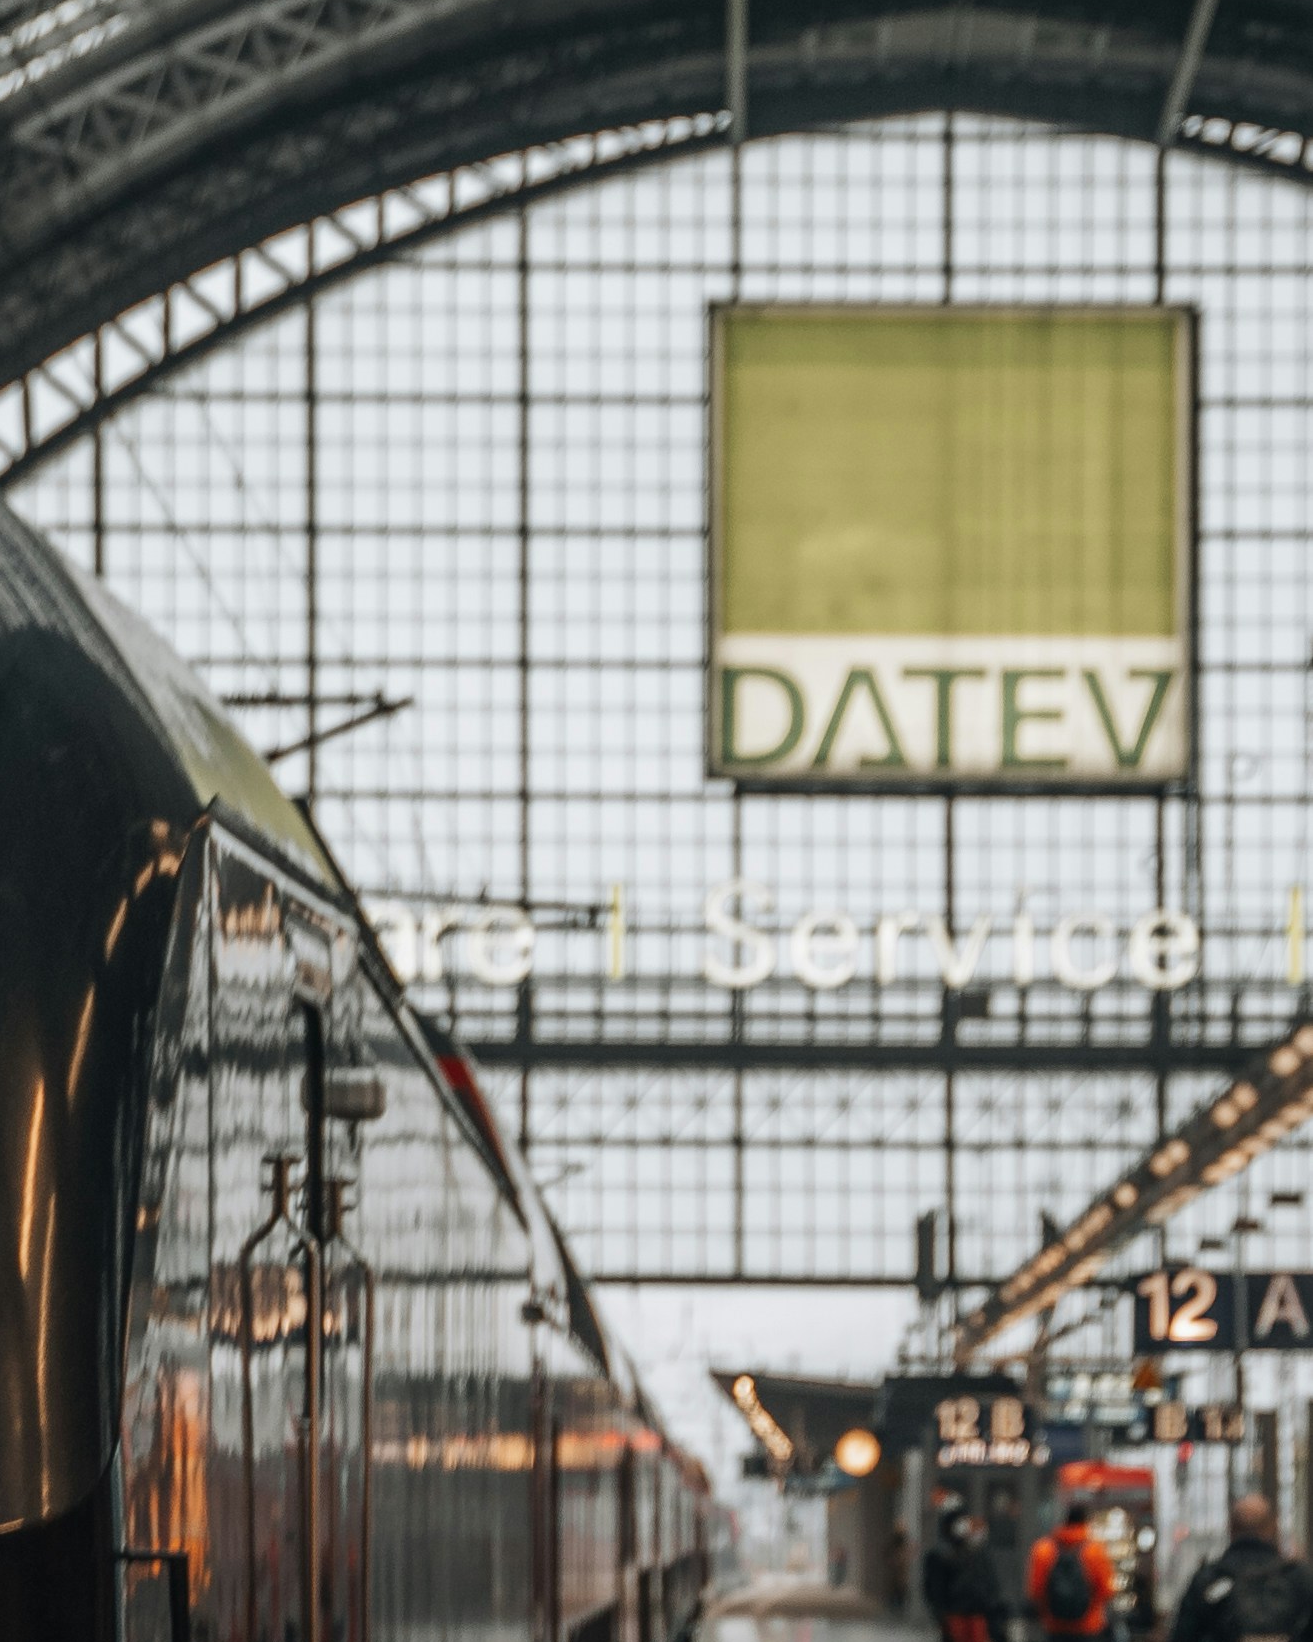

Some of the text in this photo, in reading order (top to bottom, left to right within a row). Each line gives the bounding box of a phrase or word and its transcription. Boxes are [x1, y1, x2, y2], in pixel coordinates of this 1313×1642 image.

[720, 665, 1175, 768] DATEV
[702, 875, 1202, 989] Service
[1137, 1266, 1309, 1342] 12 A
